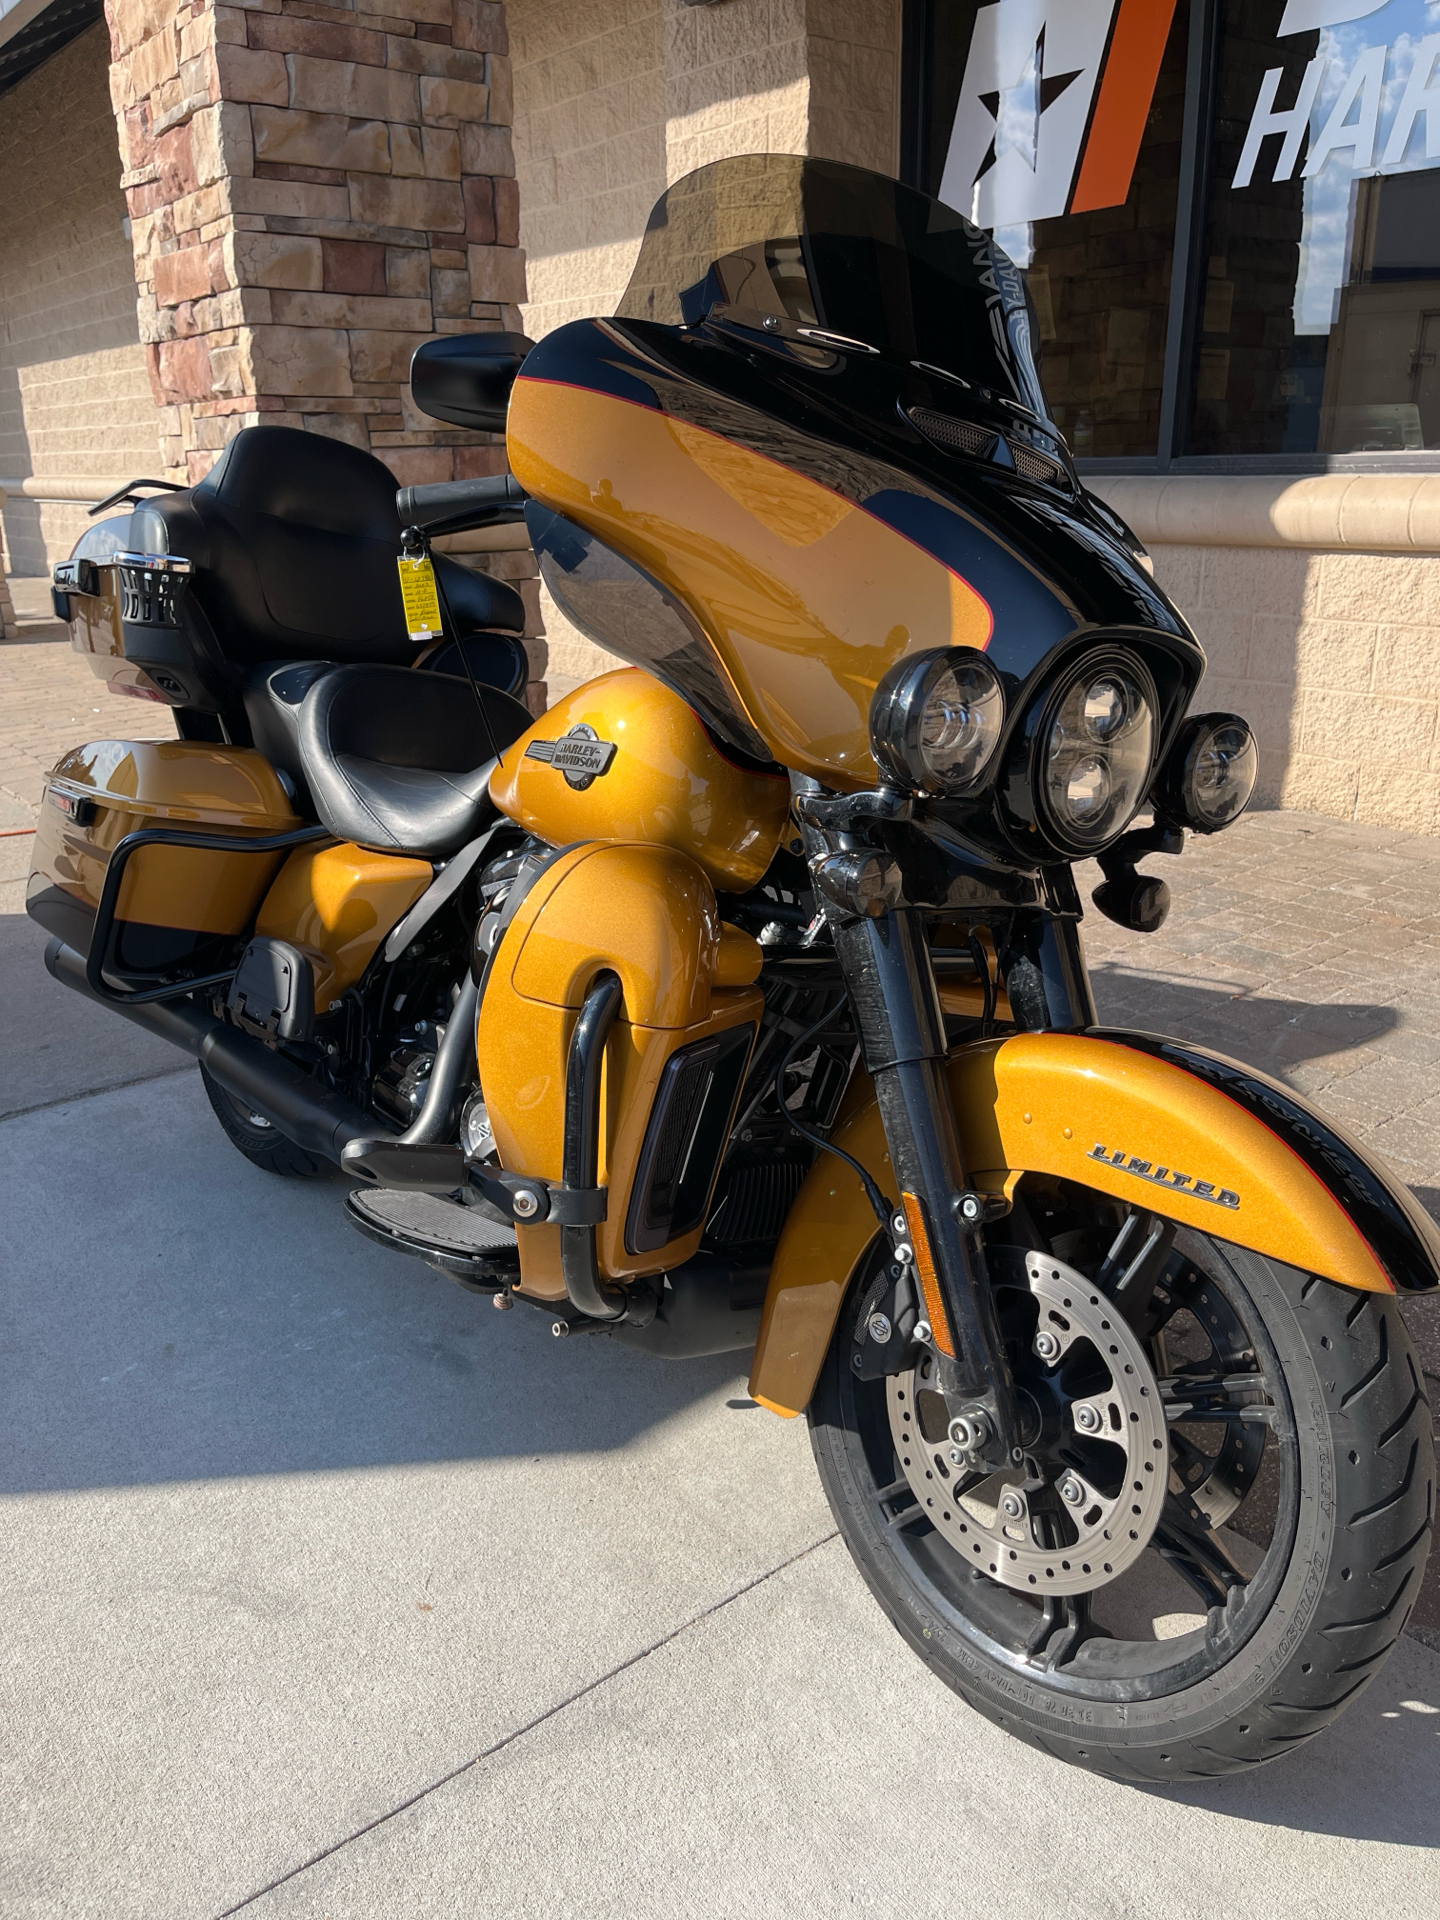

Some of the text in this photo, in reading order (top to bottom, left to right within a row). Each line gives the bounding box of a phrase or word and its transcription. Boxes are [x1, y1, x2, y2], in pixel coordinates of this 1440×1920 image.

[555, 753, 601, 769] DAVIDSON
[1087, 1142, 1240, 1210] LIMITED
[1267, 1550, 1324, 1671] DAVIDSON
